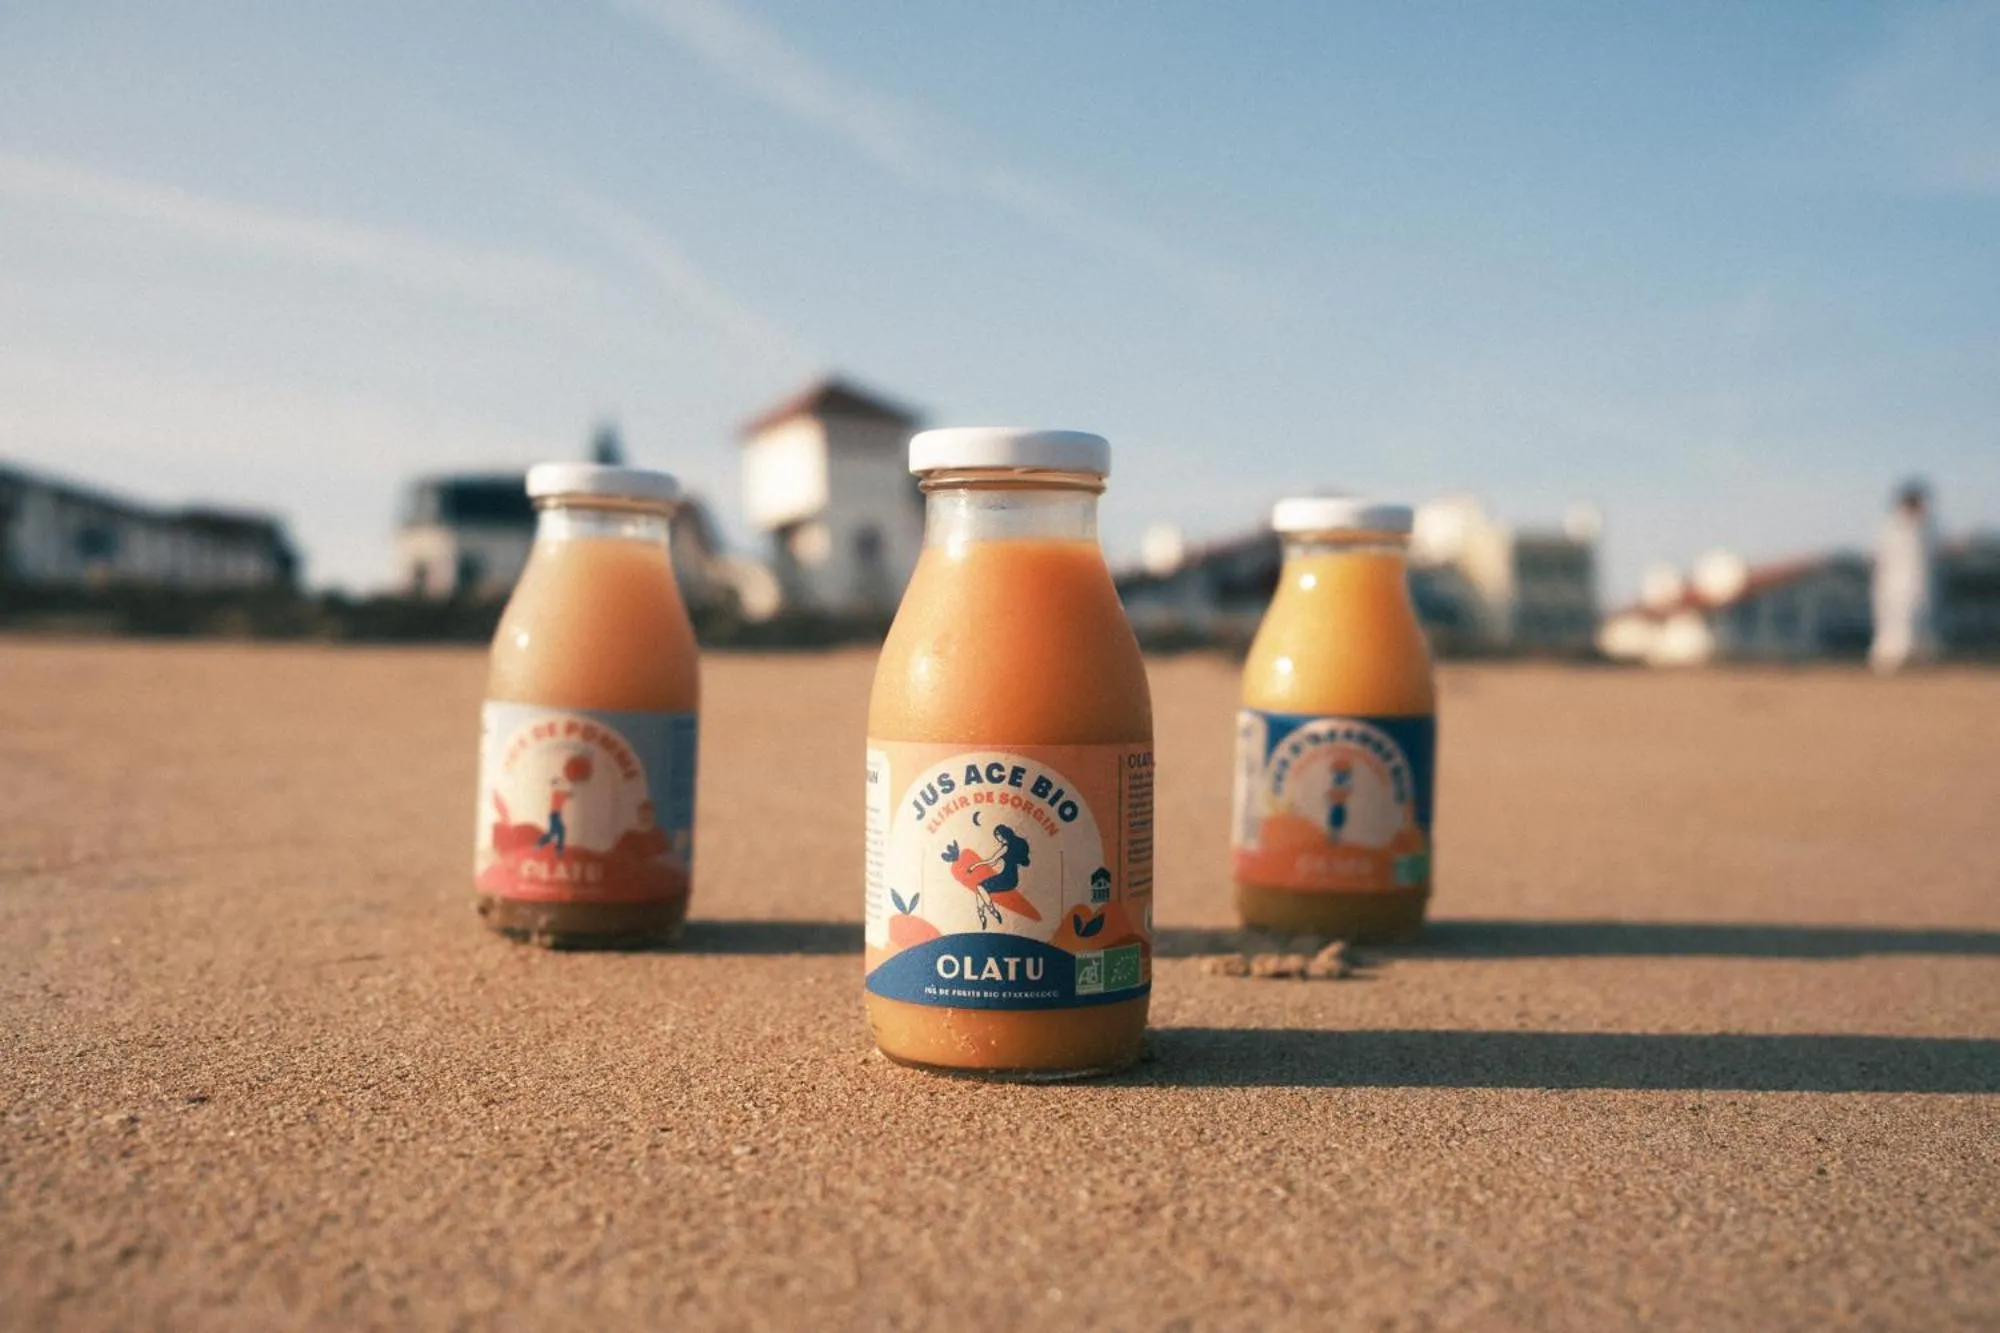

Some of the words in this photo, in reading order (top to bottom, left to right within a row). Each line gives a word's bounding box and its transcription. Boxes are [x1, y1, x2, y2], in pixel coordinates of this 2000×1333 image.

[912, 772, 956, 821] JUS
[964, 762, 1026, 787] ACE
[1030, 774, 1079, 823] BIO
[926, 796, 970, 835] ELIXIR
[973, 791, 995, 805] DE
[998, 791, 1061, 838] SORGIN
[936, 953, 1045, 981] OLATU
[983, 990, 1000, 999] BIO
